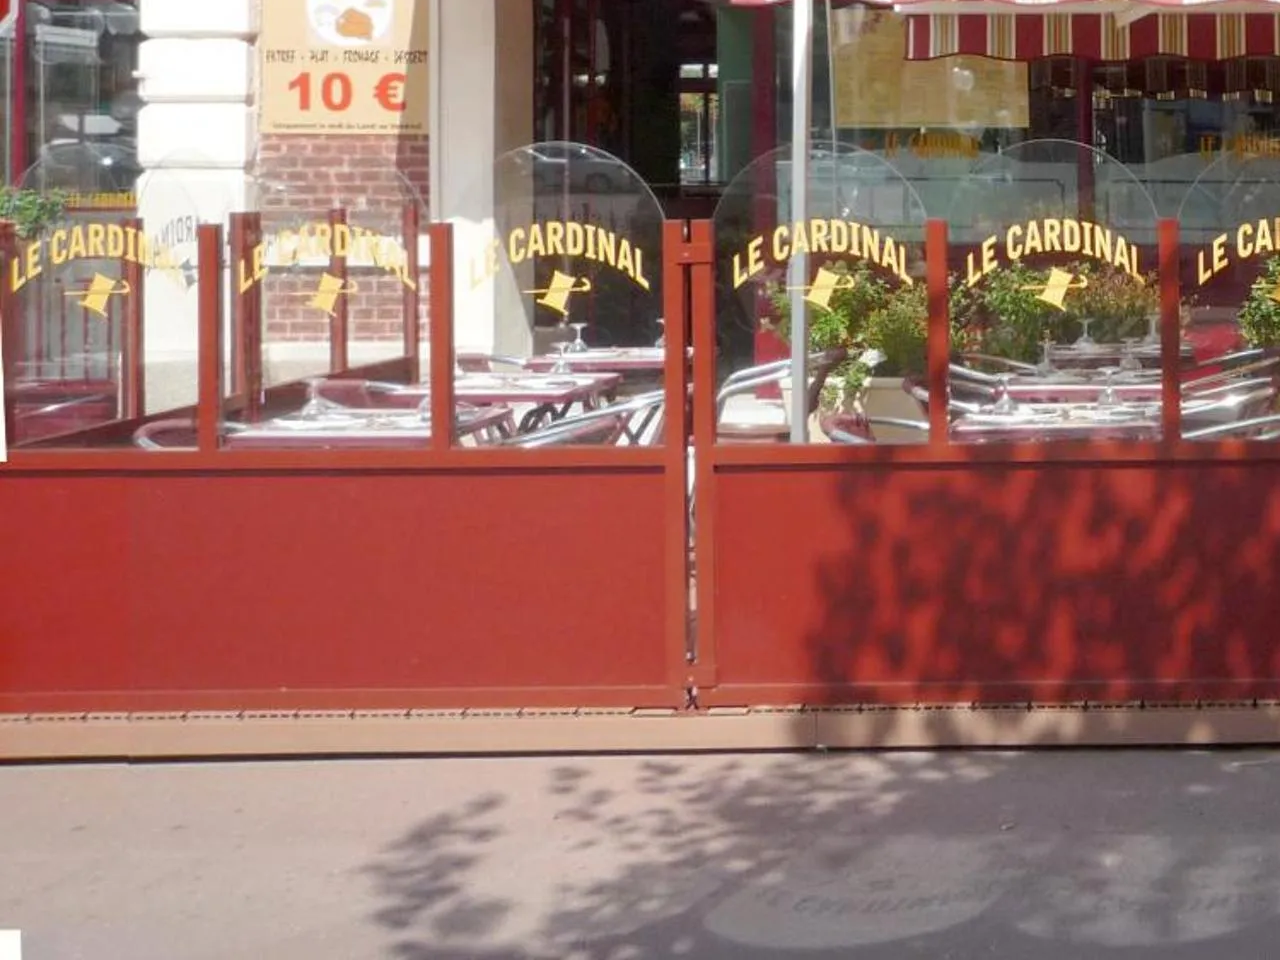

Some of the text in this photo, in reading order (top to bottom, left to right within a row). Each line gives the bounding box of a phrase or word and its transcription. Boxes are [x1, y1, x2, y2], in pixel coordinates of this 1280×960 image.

[288, 72, 407, 112] 10 €
[10, 240, 42, 293] LE
[239, 240, 268, 294] LE
[469, 221, 650, 291] LE CARDINAL
[733, 219, 913, 289] LE CARDINAL
[966, 219, 1146, 288] LE CARDINAL
[1198, 233, 1228, 286] LE
